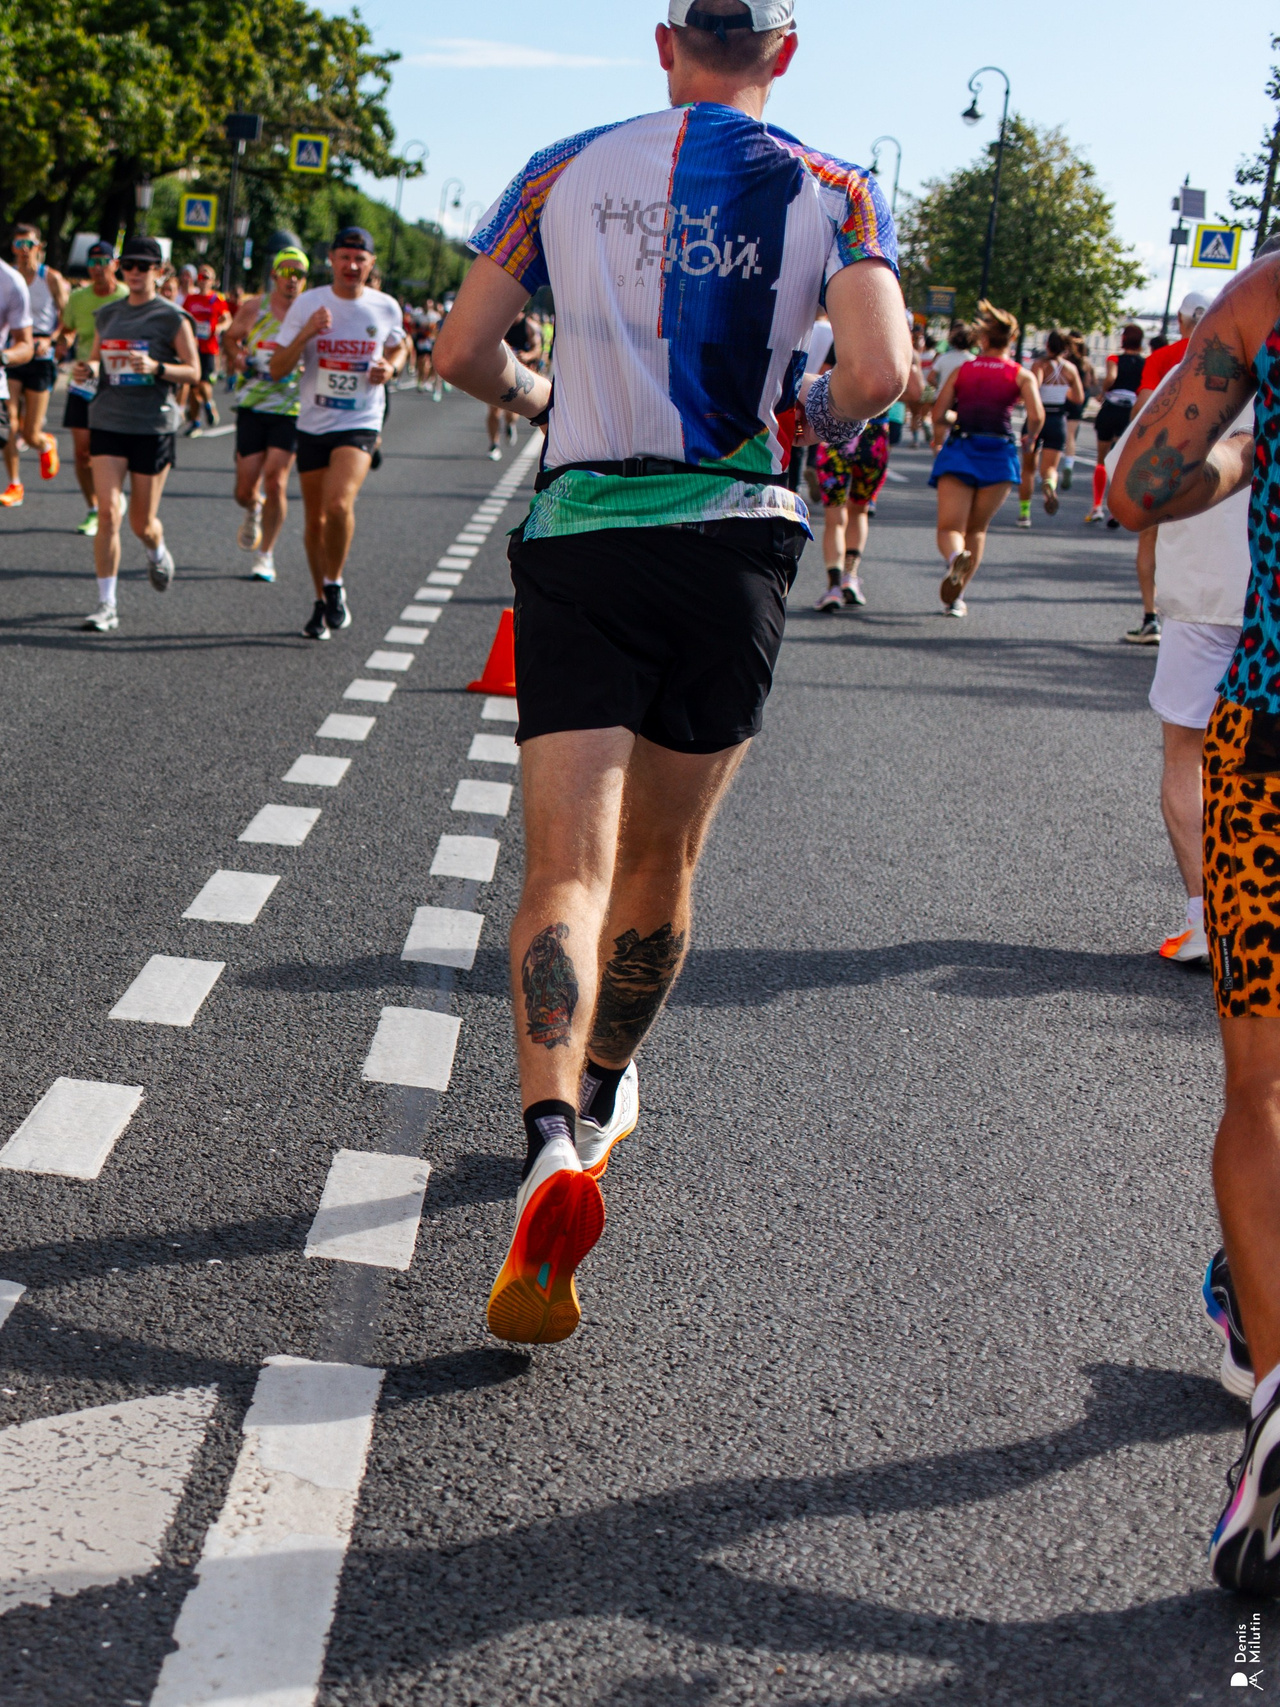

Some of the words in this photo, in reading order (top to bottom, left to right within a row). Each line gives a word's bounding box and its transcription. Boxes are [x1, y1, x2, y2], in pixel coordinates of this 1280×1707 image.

[317, 339, 377, 355] RUSSIA
[328, 373, 358, 391] 523
[1222, 937, 1227, 947] ME
[1223, 948, 1228, 956] BY
